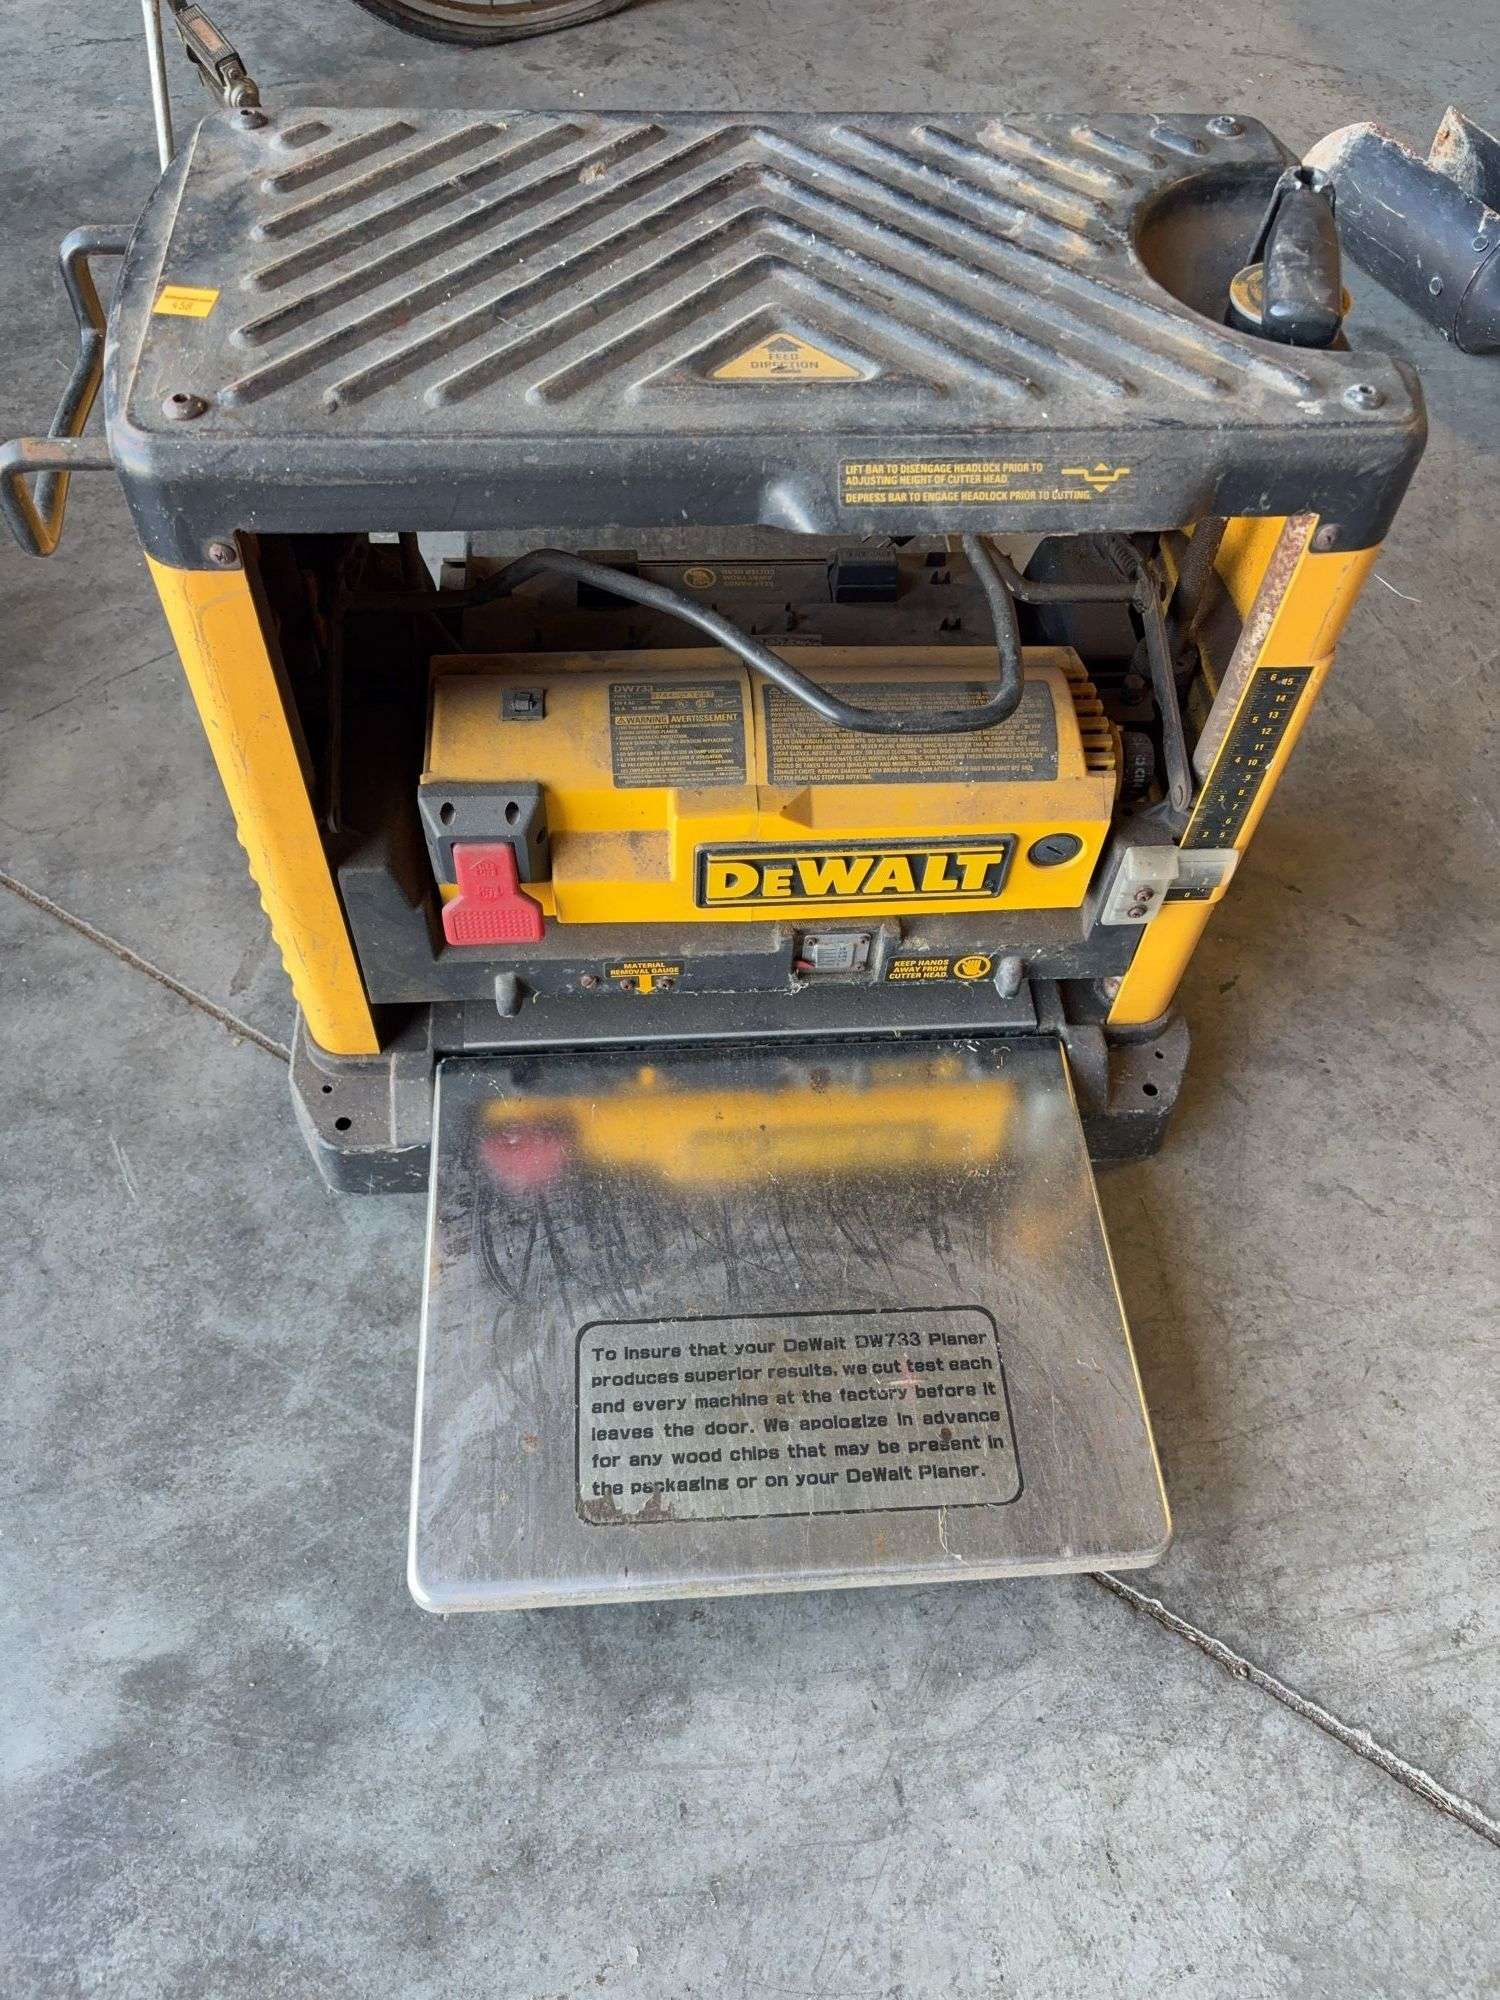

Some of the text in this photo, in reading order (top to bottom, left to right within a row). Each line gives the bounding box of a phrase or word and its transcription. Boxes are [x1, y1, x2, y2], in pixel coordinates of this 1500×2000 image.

[845, 462, 1043, 475] LIFT BAR TO DISENGAGE HEADLOCK PRIOR TO
[845, 476, 898, 486] ADJUSTING
[899, 475, 933, 485] HEIGHT
[934, 475, 946, 485] OF
[947, 475, 981, 485] CUTTER
[845, 492, 887, 503] DEPRESS
[888, 492, 907, 502] BAR
[909, 492, 921, 502] TO
[923, 491, 960, 501] ENGAGE
[961, 491, 1007, 501] HEADLOCK
[1009, 490, 1037, 500] PRIOR
[1038, 490, 1050, 500] TO
[1270, 673, 1277, 682] 6
[1275, 694, 1287, 704] 14
[626, 713, 738, 725] WARNING AVERTISSEMENT
[1251, 716, 1259, 725] 5
[1268, 711, 1280, 720] 13
[1261, 727, 1273, 736] 12
[1254, 743, 1265, 752] 11
[1234, 756, 1258, 767] 4 10
[1244, 774, 1252, 783] 9
[1218, 794, 1225, 803] 3
[1232, 802, 1239, 811] 7
[1202, 831, 1226, 839] 2 5
[623, 962, 666, 970] MATERIAL
[610, 968, 649, 976] REMOVAL
[592, 1348, 616, 1361] To
[689, 1342, 727, 1356] that
[735, 1343, 775, 1355] your
[784, 1337, 846, 1352] DeWalt
[855, 1332, 921, 1348] DW733
[929, 1333, 986, 1345] Planer
[592, 1357, 992, 1386] produces superior results, we cut test each
[592, 1399, 624, 1413] and
[633, 1399, 686, 1411] every
[695, 1394, 768, 1408] machine
[776, 1391, 794, 1404] at
[802, 1390, 832, 1403] the
[840, 1389, 907, 1401] factory
[915, 1385, 976, 1398] before
[592, 1428, 653, 1441] leaves
[664, 1423, 694, 1437] the
[705, 1423, 754, 1435] door.
[764, 1418, 789, 1432] We
[800, 1415, 887, 1430] apologize
[923, 1411, 1000, 1424] advance
[592, 1454, 620, 1468] for
[630, 1454, 662, 1466] any
[672, 1449, 721, 1464] wood
[730, 1447, 779, 1461] chips
[787, 1443, 827, 1458] that
[835, 1444, 869, 1456] may
[878, 1440, 900, 1454] be
[908, 1437, 981, 1451] present
[592, 1482, 623, 1496] the
[737, 1477, 757, 1489] or
[765, 1475, 788, 1487] on
[796, 1472, 839, 1486] your
[846, 1466, 912, 1483] DeWalt
[919, 1465, 985, 1479] Planer.
